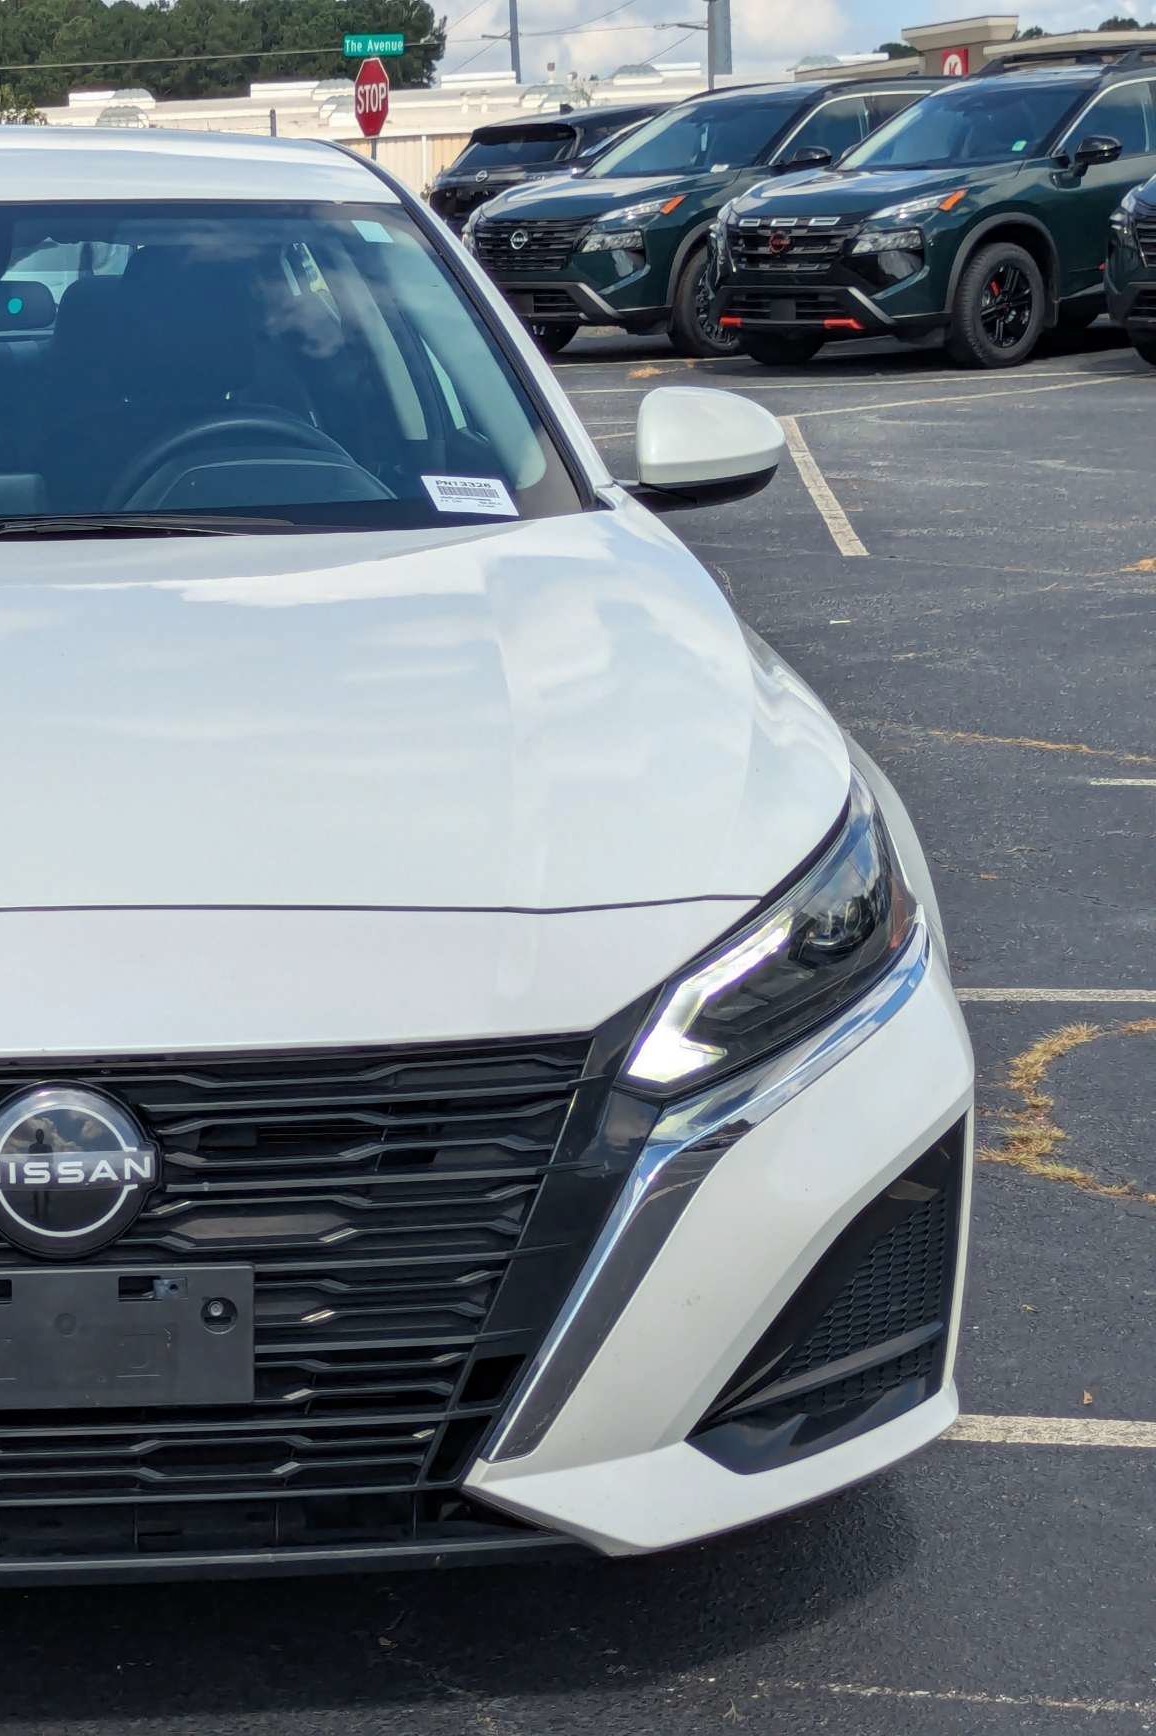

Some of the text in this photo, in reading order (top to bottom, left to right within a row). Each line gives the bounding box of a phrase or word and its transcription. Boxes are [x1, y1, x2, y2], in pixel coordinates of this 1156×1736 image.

[346, 39, 404, 52] The Avenue
[357, 82, 387, 114] STOP
